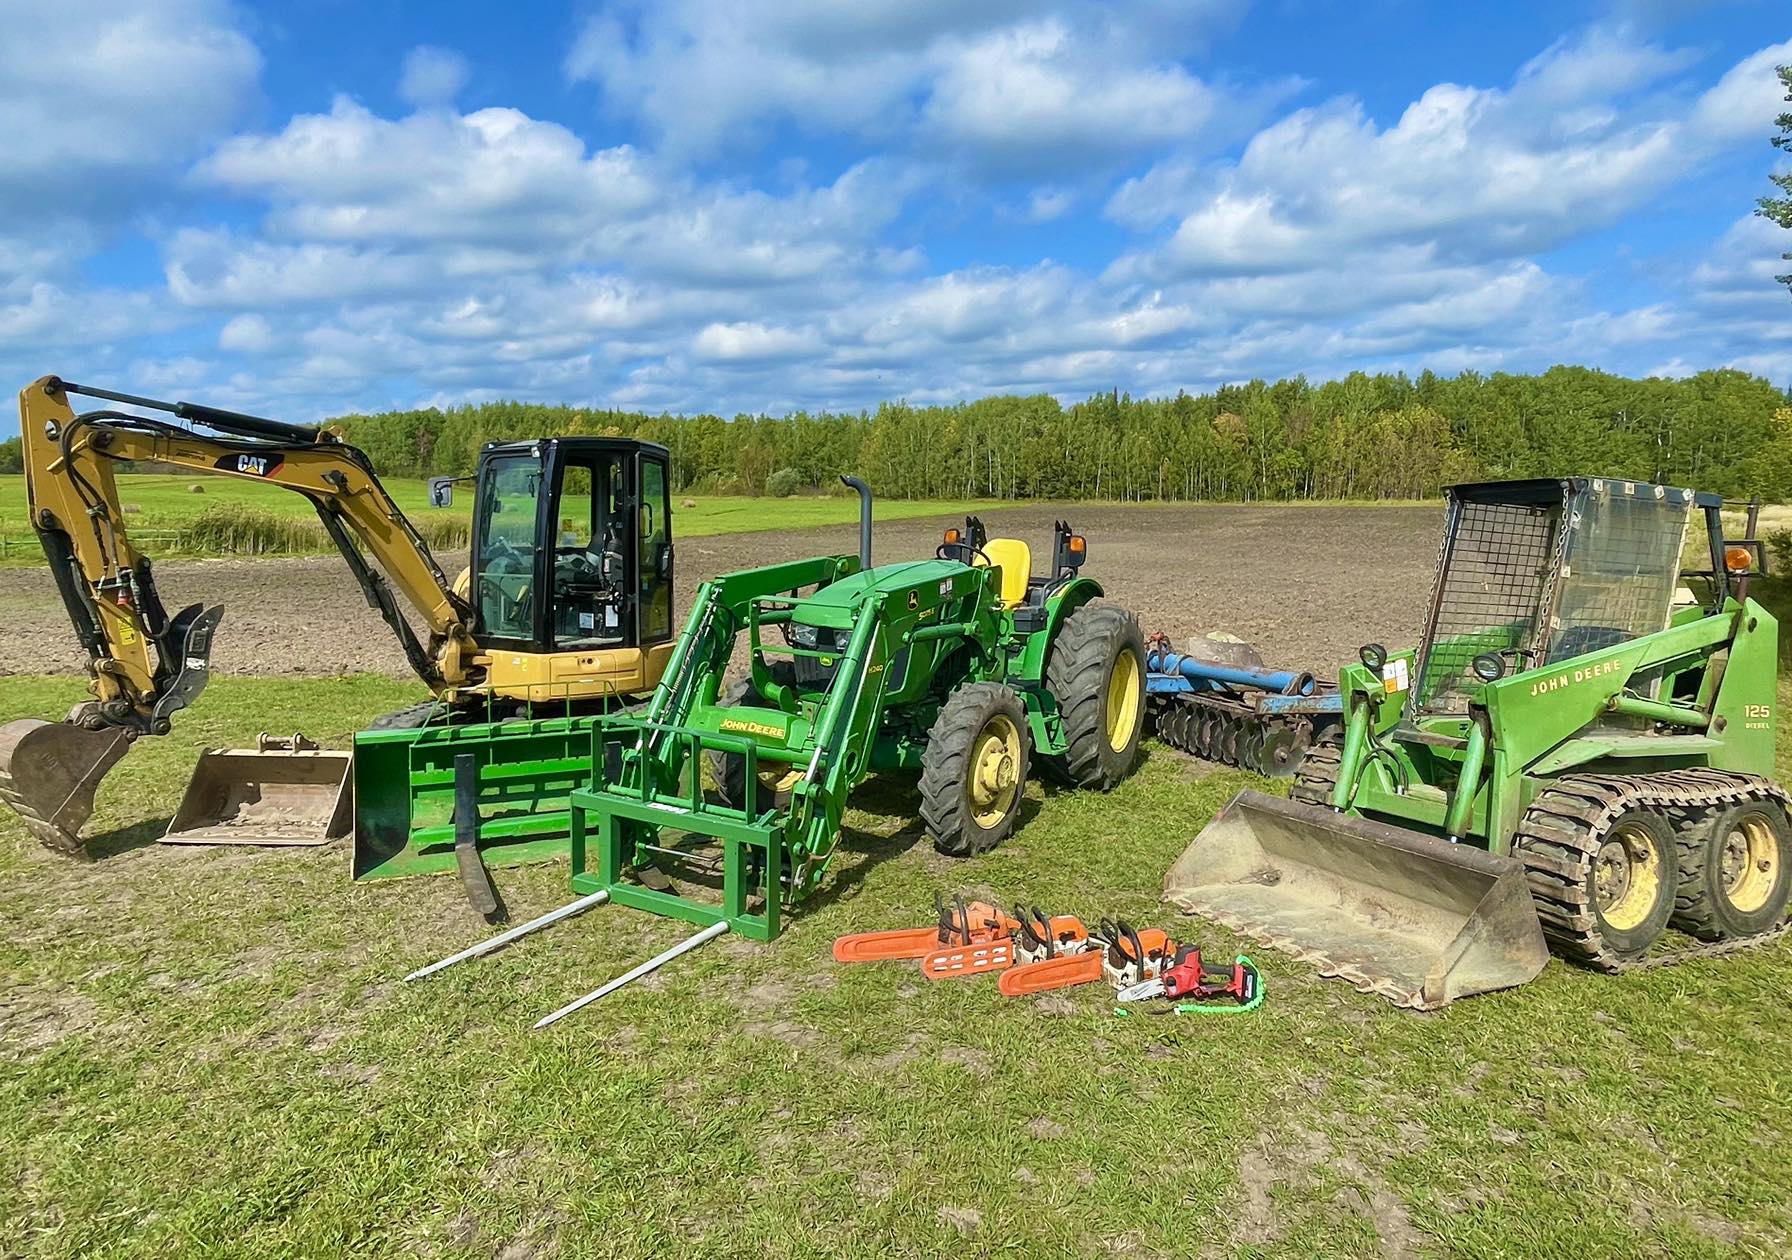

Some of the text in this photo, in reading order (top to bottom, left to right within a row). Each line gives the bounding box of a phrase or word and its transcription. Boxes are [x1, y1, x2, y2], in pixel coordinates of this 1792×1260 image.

[237, 454, 267, 475] CAT
[1531, 659, 1621, 697] JOHN DEERE
[1744, 704, 1770, 718] 125
[720, 718, 785, 737] JOHN DEERE
